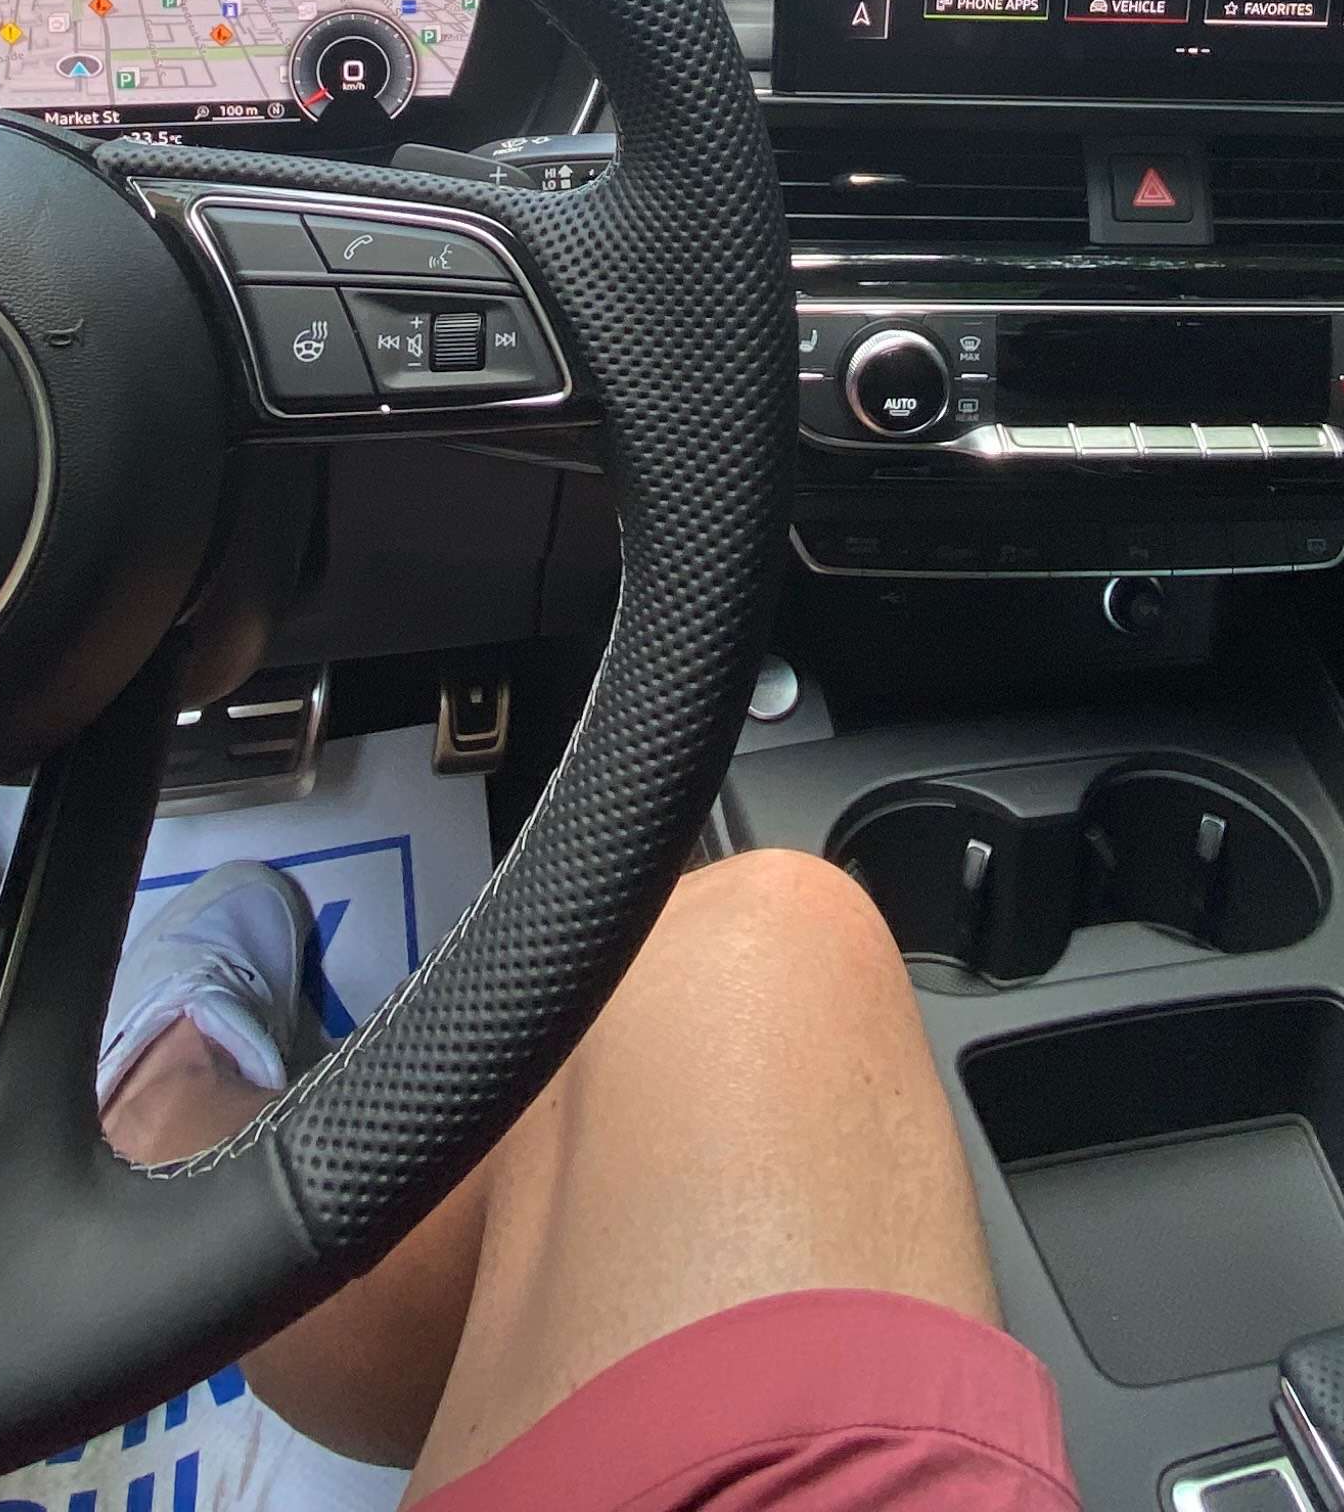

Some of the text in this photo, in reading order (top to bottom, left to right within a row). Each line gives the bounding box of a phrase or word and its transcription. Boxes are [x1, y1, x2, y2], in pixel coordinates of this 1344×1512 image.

[1111, 0, 1166, 13] VEHICLE
[1244, 2, 1313, 16] FAVORITES
[343, 60, 364, 82] 0
[342, 82, 365, 91] km/h
[219, 105, 258, 117] 100 m
[44, 111, 120, 125] Market St
[544, 168, 557, 179] HI
[542, 180, 557, 191] LO
[959, 353, 980, 361] MAX
[883, 398, 917, 410] AUTO
